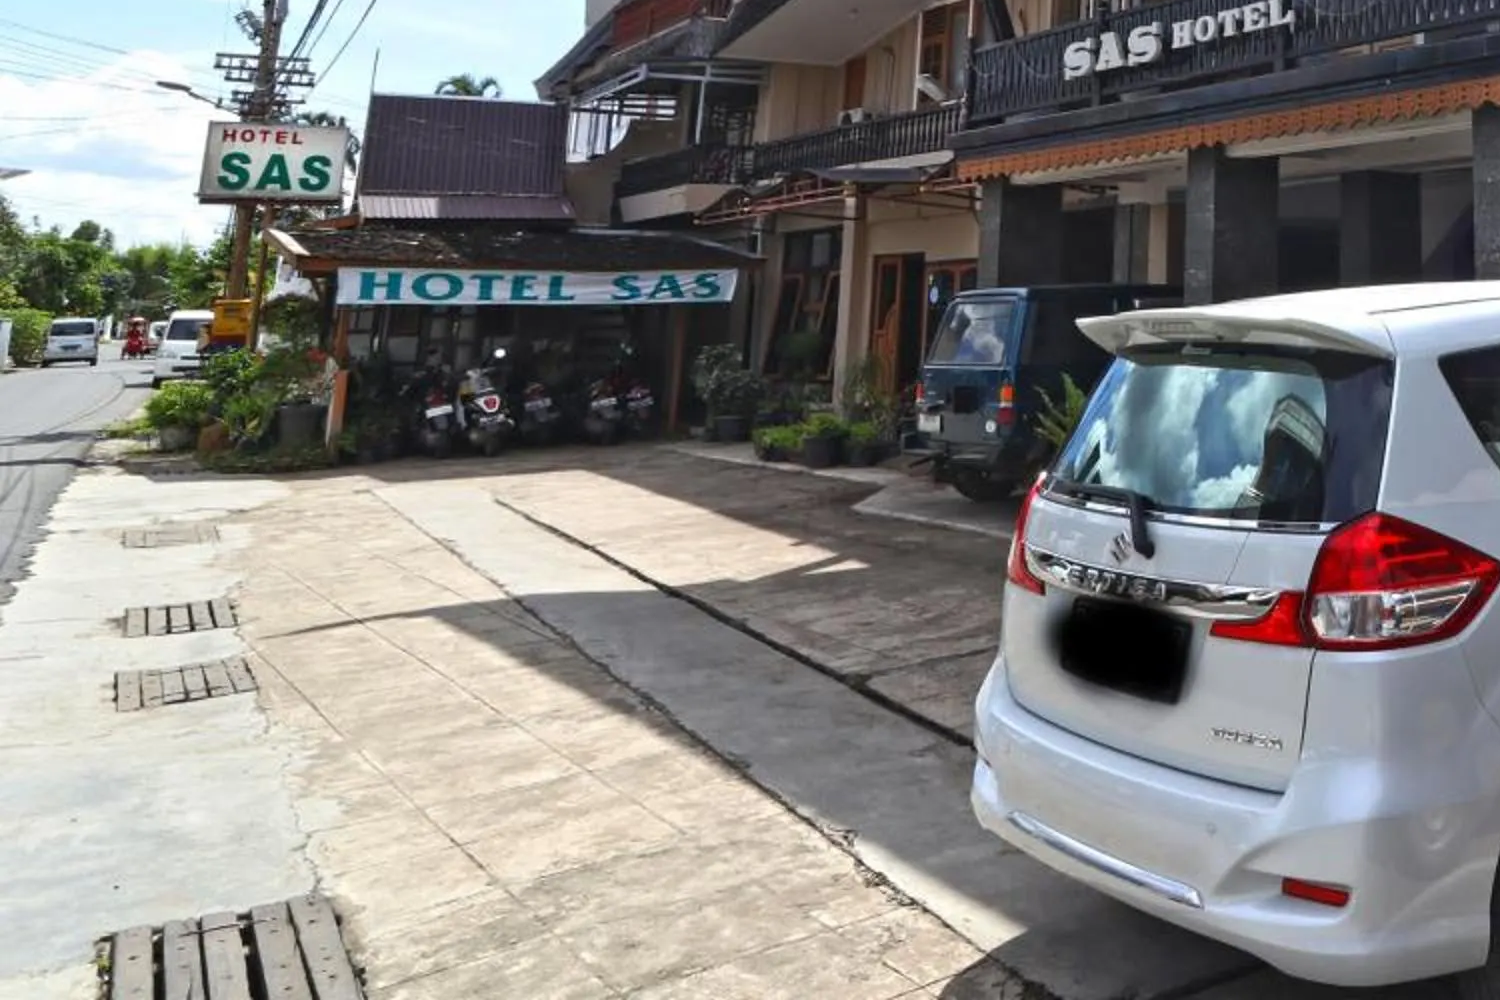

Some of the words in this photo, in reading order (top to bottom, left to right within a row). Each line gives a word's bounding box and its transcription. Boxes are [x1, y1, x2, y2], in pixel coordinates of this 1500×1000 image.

[1063, 21, 1162, 81] SAS
[222, 128, 305, 145] HOTEL
[217, 151, 332, 192] SAS
[357, 271, 576, 301] HOTEL
[611, 273, 722, 299] SAS
